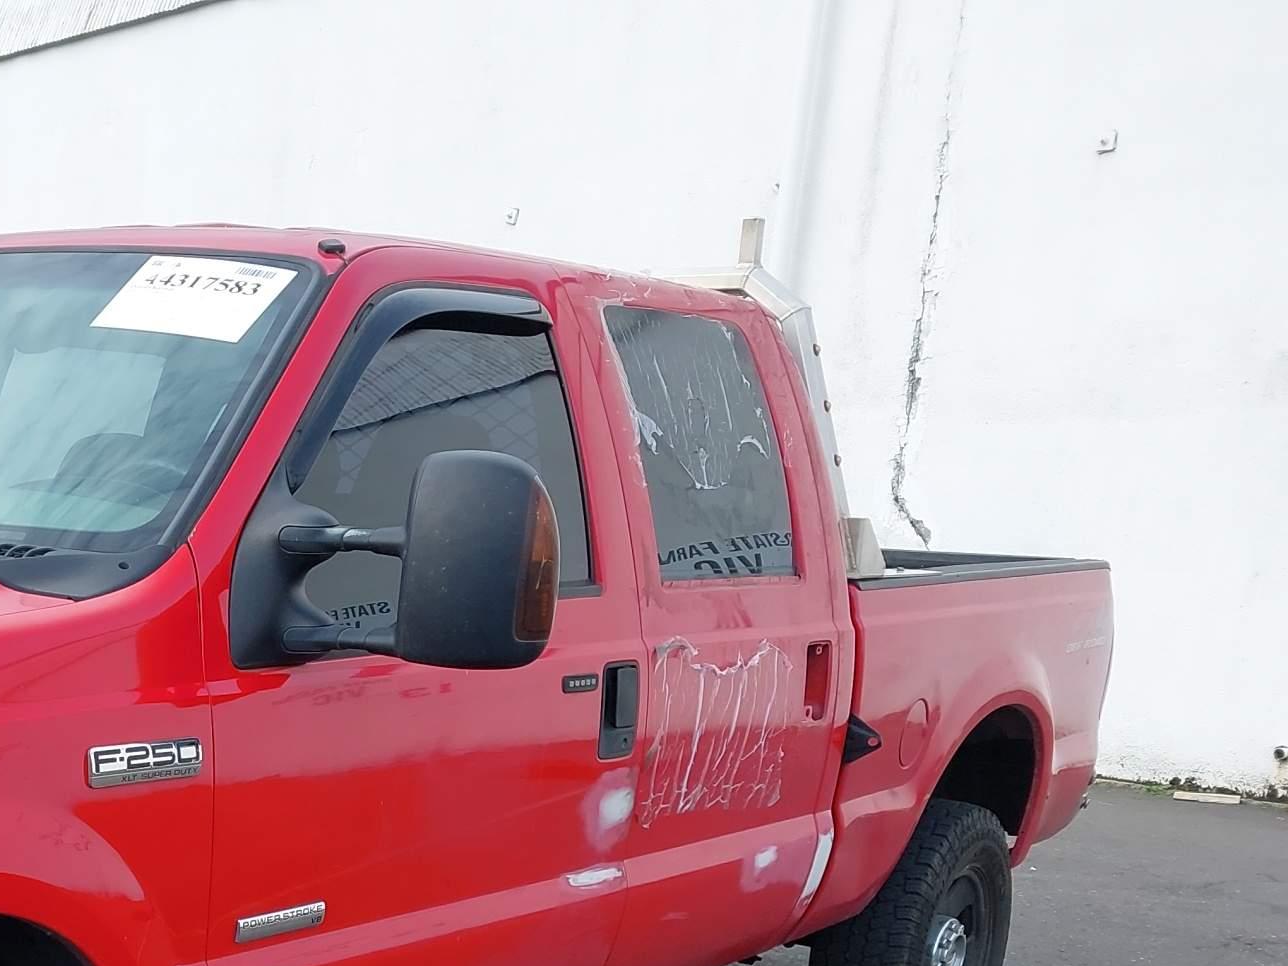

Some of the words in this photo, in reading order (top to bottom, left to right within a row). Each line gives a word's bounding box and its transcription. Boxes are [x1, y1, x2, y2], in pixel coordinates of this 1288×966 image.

[145, 273, 261, 296] 44317583
[141, 769, 172, 779] SUPER
[174, 766, 200, 776] DUTY
